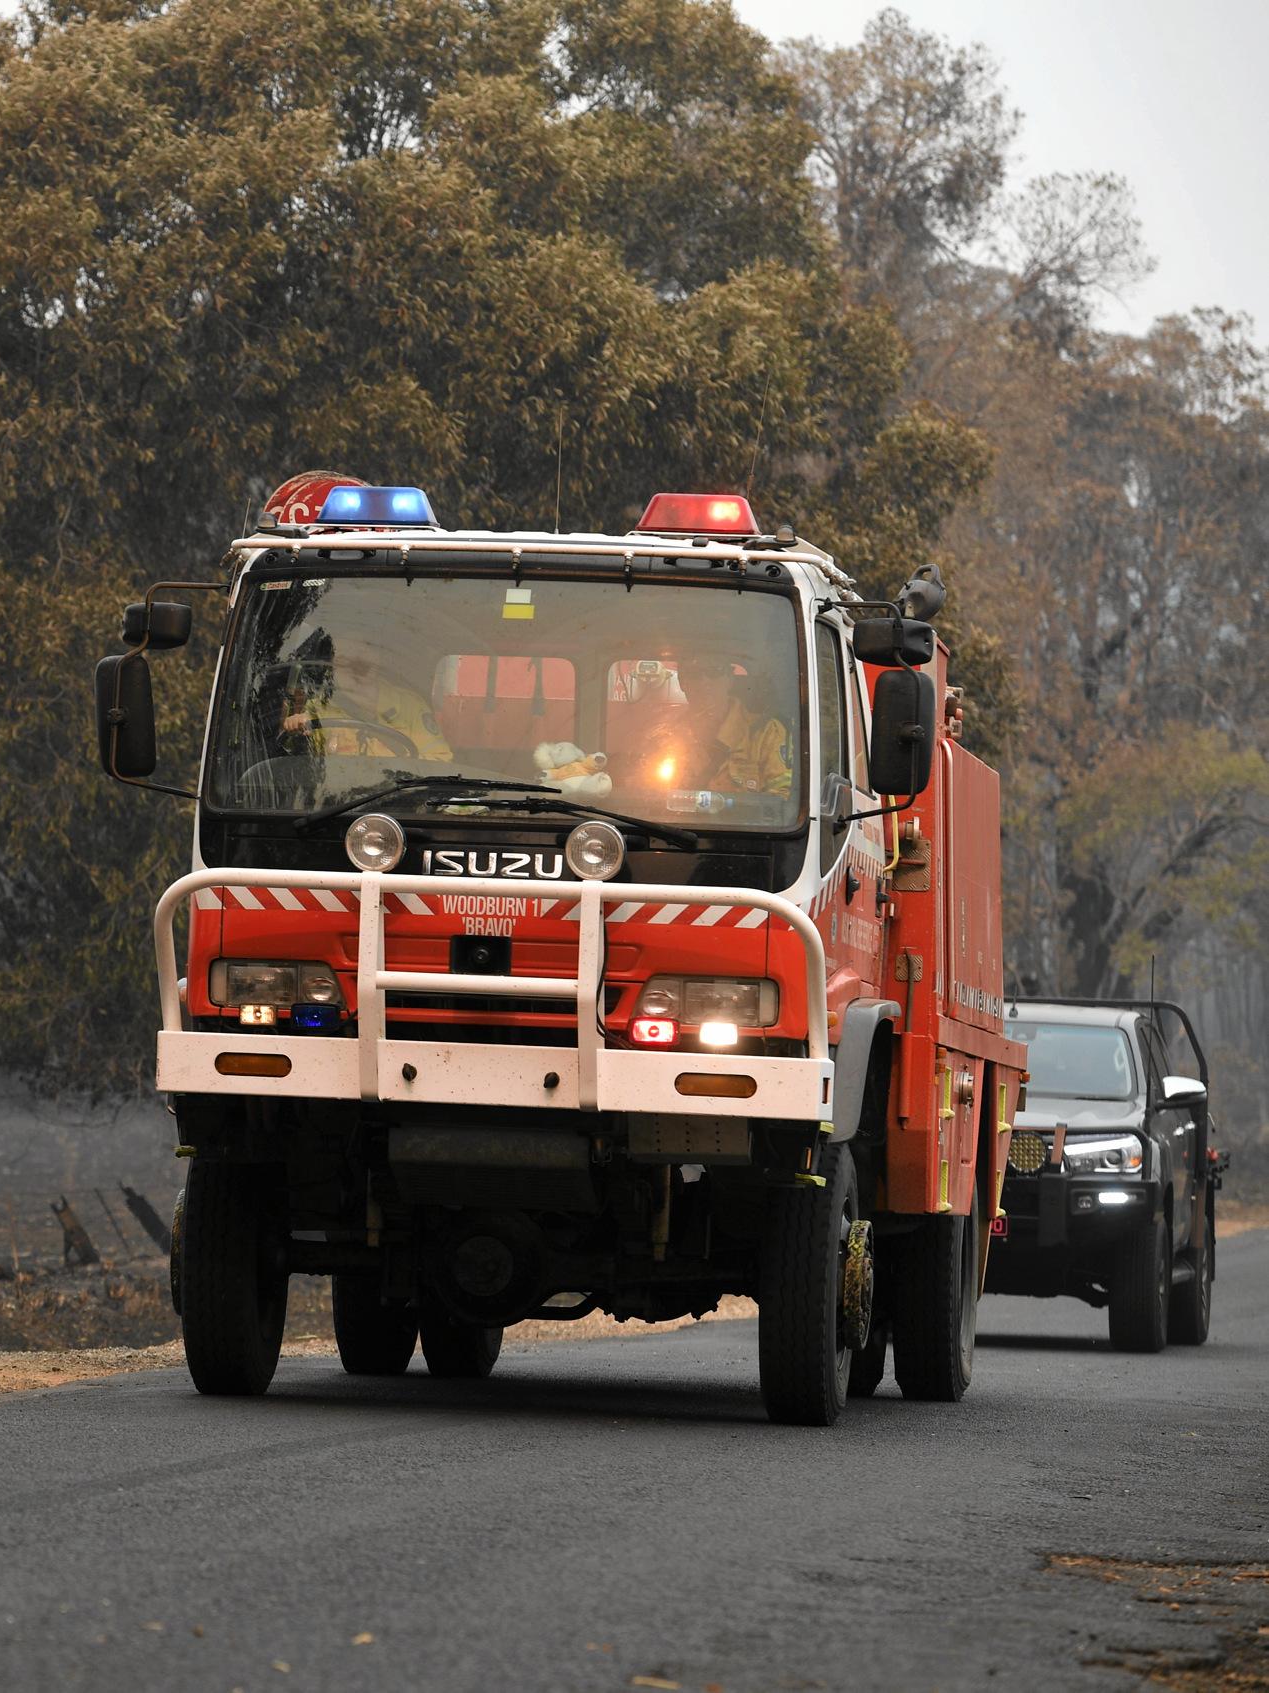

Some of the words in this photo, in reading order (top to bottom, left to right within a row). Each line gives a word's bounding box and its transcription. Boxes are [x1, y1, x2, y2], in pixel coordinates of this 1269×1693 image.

[422, 850, 563, 878] ISUZU
[442, 895, 527, 917] WOODBURN
[462, 917, 517, 937] 'BRAVO'
